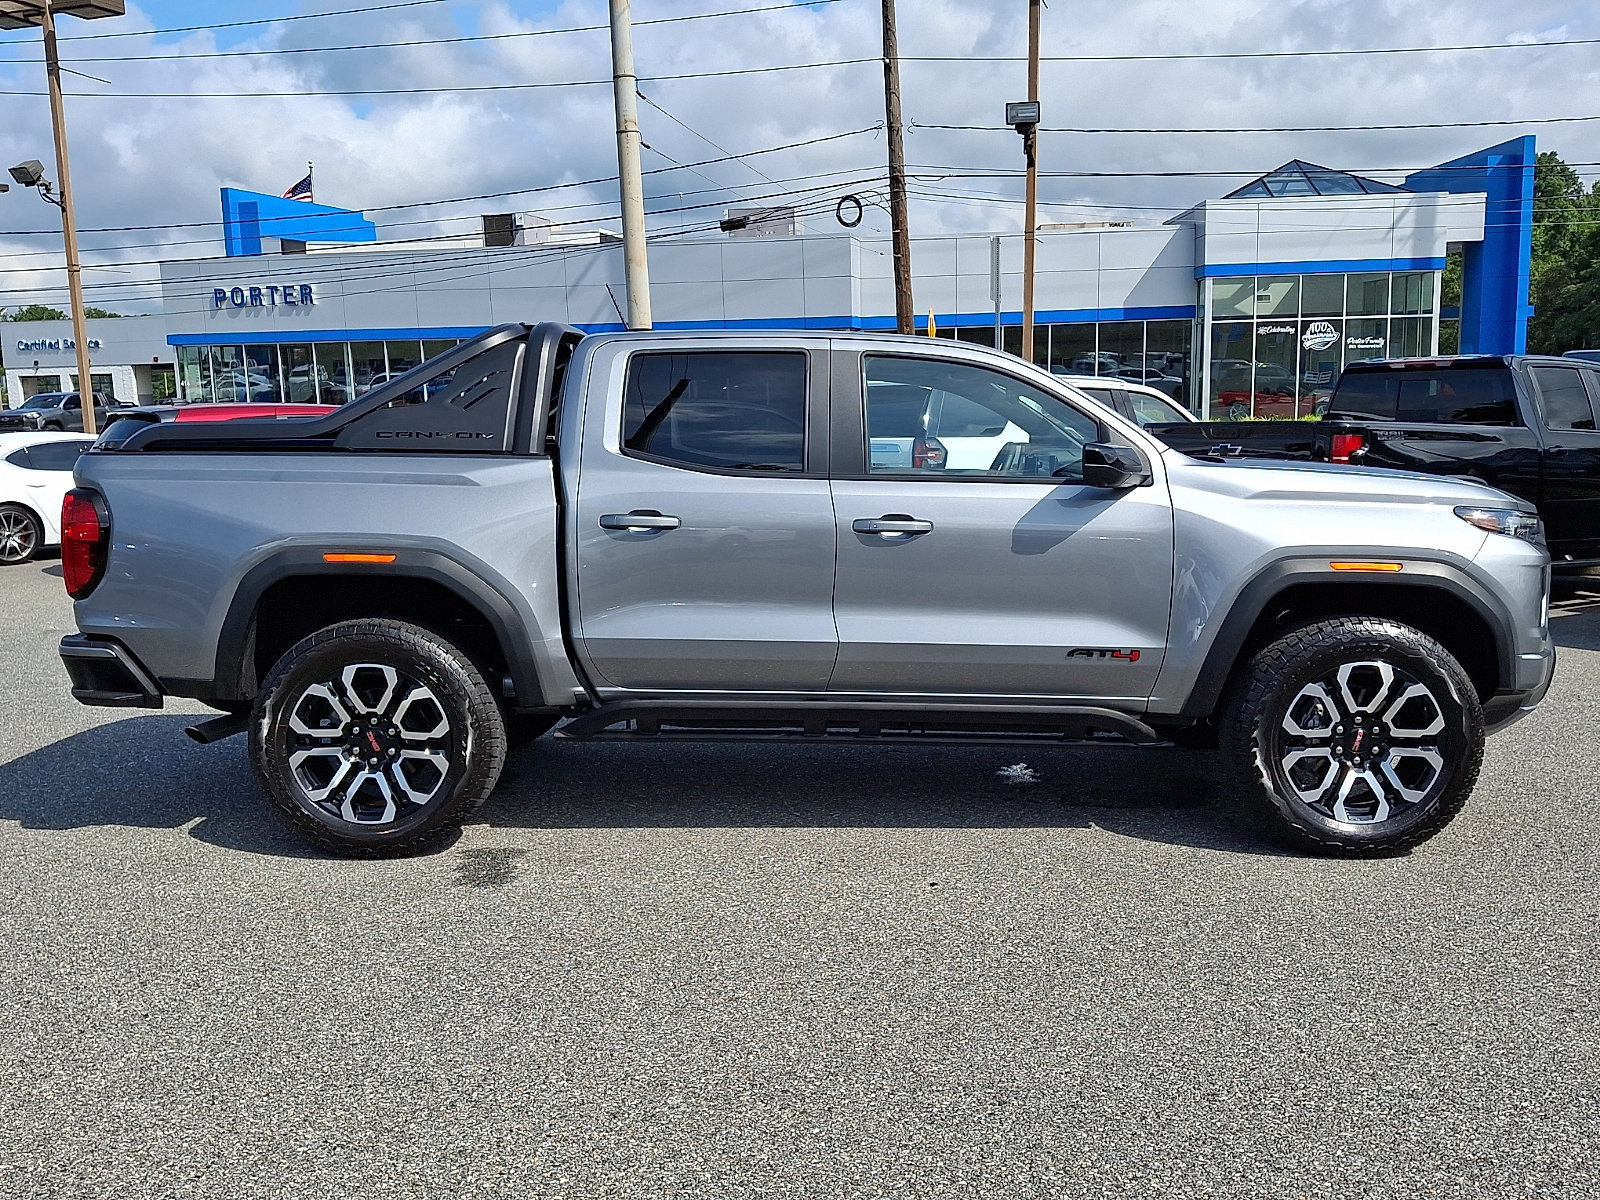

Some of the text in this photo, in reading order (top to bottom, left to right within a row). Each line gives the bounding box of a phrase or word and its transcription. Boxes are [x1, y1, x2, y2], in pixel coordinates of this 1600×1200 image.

[213, 283, 315, 308] PORTER
[17, 338, 101, 351] Certified Sece
[375, 431, 494, 440] CANYON
[1066, 647, 1141, 663] AT4
[366, 730, 381, 752] GMC
